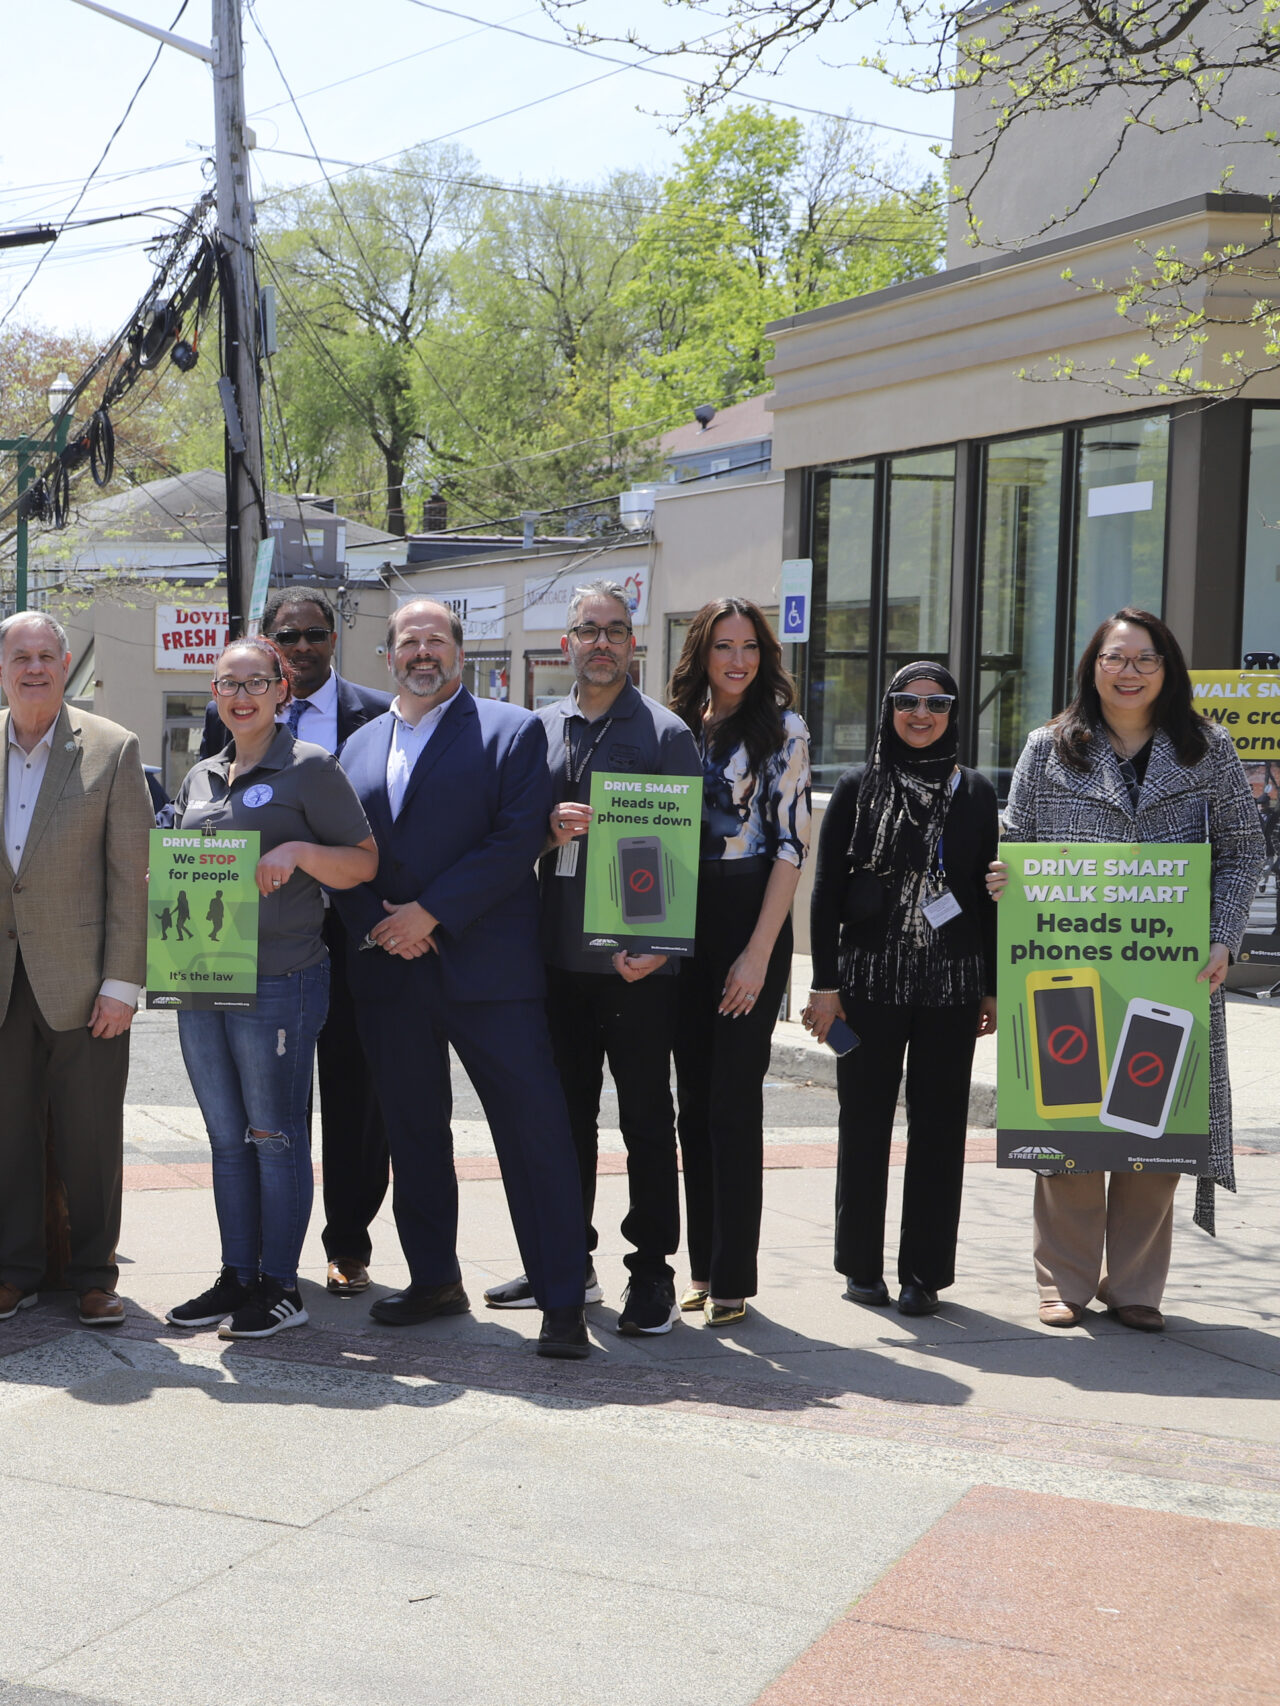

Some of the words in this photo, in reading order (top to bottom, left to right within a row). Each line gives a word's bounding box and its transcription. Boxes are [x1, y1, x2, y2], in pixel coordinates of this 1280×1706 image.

[162, 629, 216, 650] FRESH
[1193, 683, 1252, 698] WALK
[1203, 708, 1240, 724] We
[604, 781, 642, 792] DRIVE
[645, 782, 690, 794] SMART
[611, 797, 654, 809] Heads
[658, 801, 680, 812] up,
[597, 812, 649, 825] phones
[652, 814, 692, 826] down
[162, 837, 200, 848] DRIVE
[204, 838, 247, 849] SMART
[173, 853, 195, 864] We
[199, 854, 236, 865] STOP
[169, 868, 188, 880] for
[192, 869, 239, 883] people
[1023, 859, 1097, 876] DRIVE
[1103, 859, 1189, 877] SMART
[1023, 884, 1097, 902] WALK
[1103, 885, 1189, 903] SMART
[1036, 913, 1122, 933] Heads
[1131, 917, 1174, 938] up,
[1011, 940, 1112, 964] phones
[1121, 941, 1199, 962] down
[170, 971, 187, 981] It's
[189, 971, 210, 981] the
[213, 972, 234, 981] law
